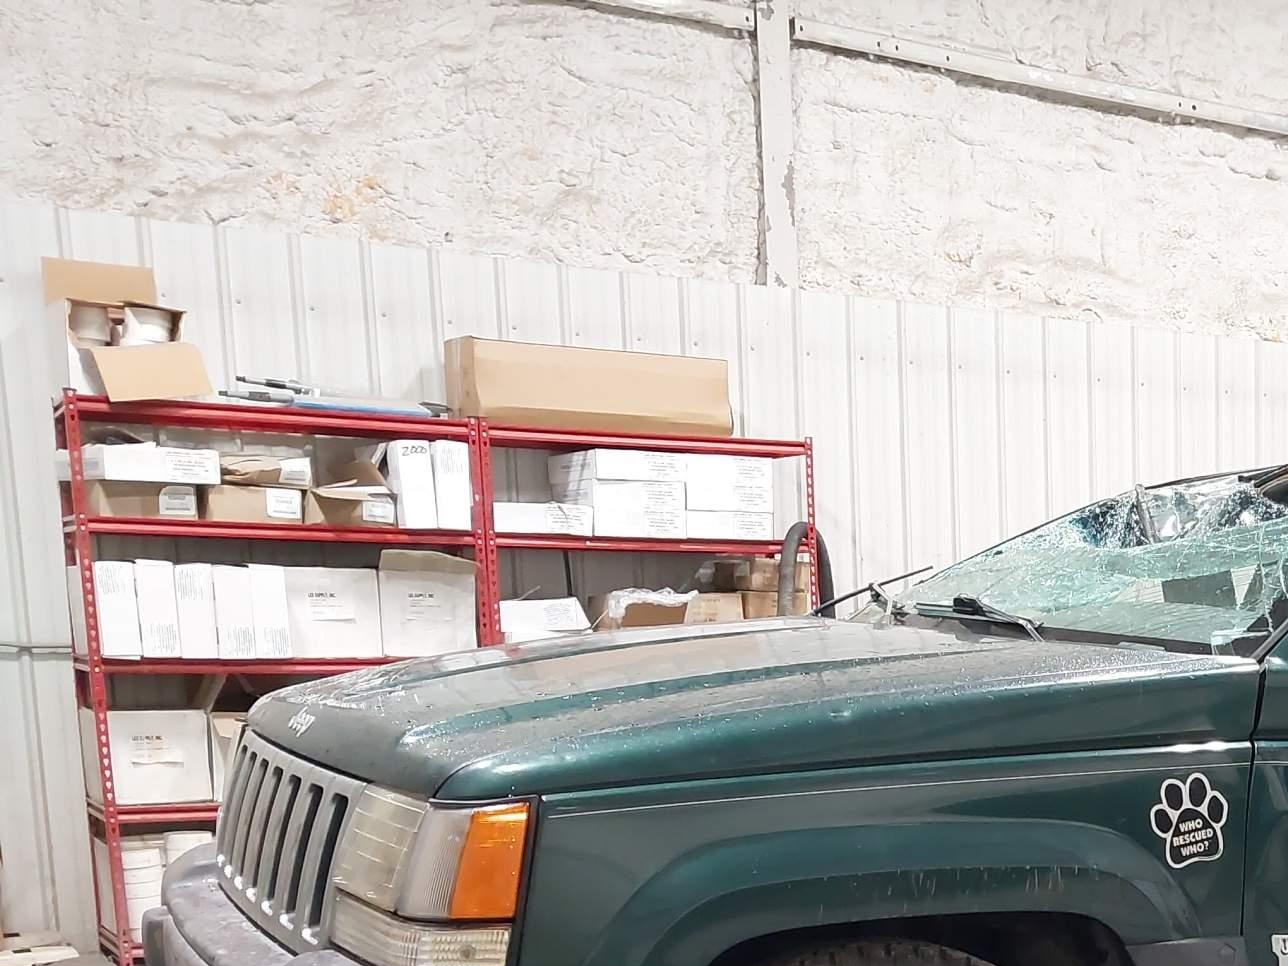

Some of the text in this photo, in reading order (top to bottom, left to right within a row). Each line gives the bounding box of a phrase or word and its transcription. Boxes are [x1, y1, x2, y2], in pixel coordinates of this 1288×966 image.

[401, 445, 427, 457] 2000
[1179, 818, 1203, 833] WHO
[1172, 828, 1214, 847] RESCUED
[1180, 841, 1209, 857] WHO?
